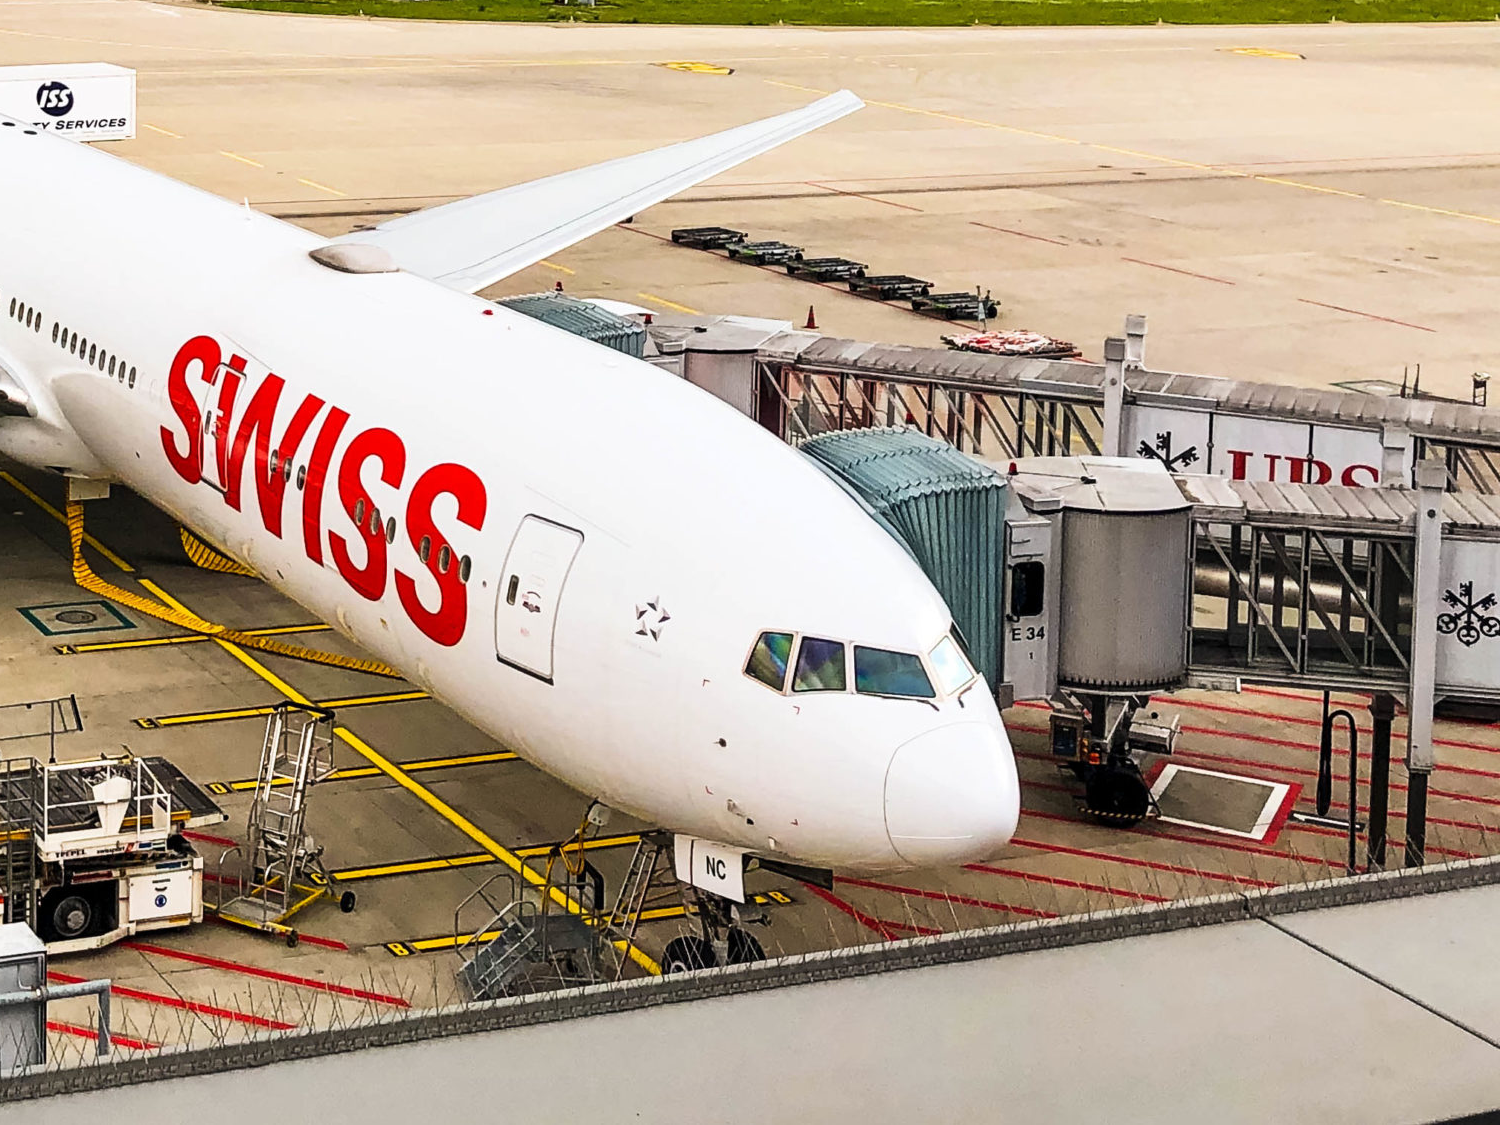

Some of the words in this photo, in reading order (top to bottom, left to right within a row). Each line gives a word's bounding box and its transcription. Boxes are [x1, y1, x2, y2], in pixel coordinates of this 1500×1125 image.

[39, 81, 71, 108] ISS
[55, 117, 127, 130] SERVICES
[159, 334, 488, 648] SWISS
[1011, 627, 1022, 641] E
[1026, 626, 1046, 641] 34
[1028, 651, 1034, 660] 1
[137, 717, 156, 729] E
[706, 855, 726, 880] NC
[767, 891, 792, 904] B
[386, 942, 410, 957] B
